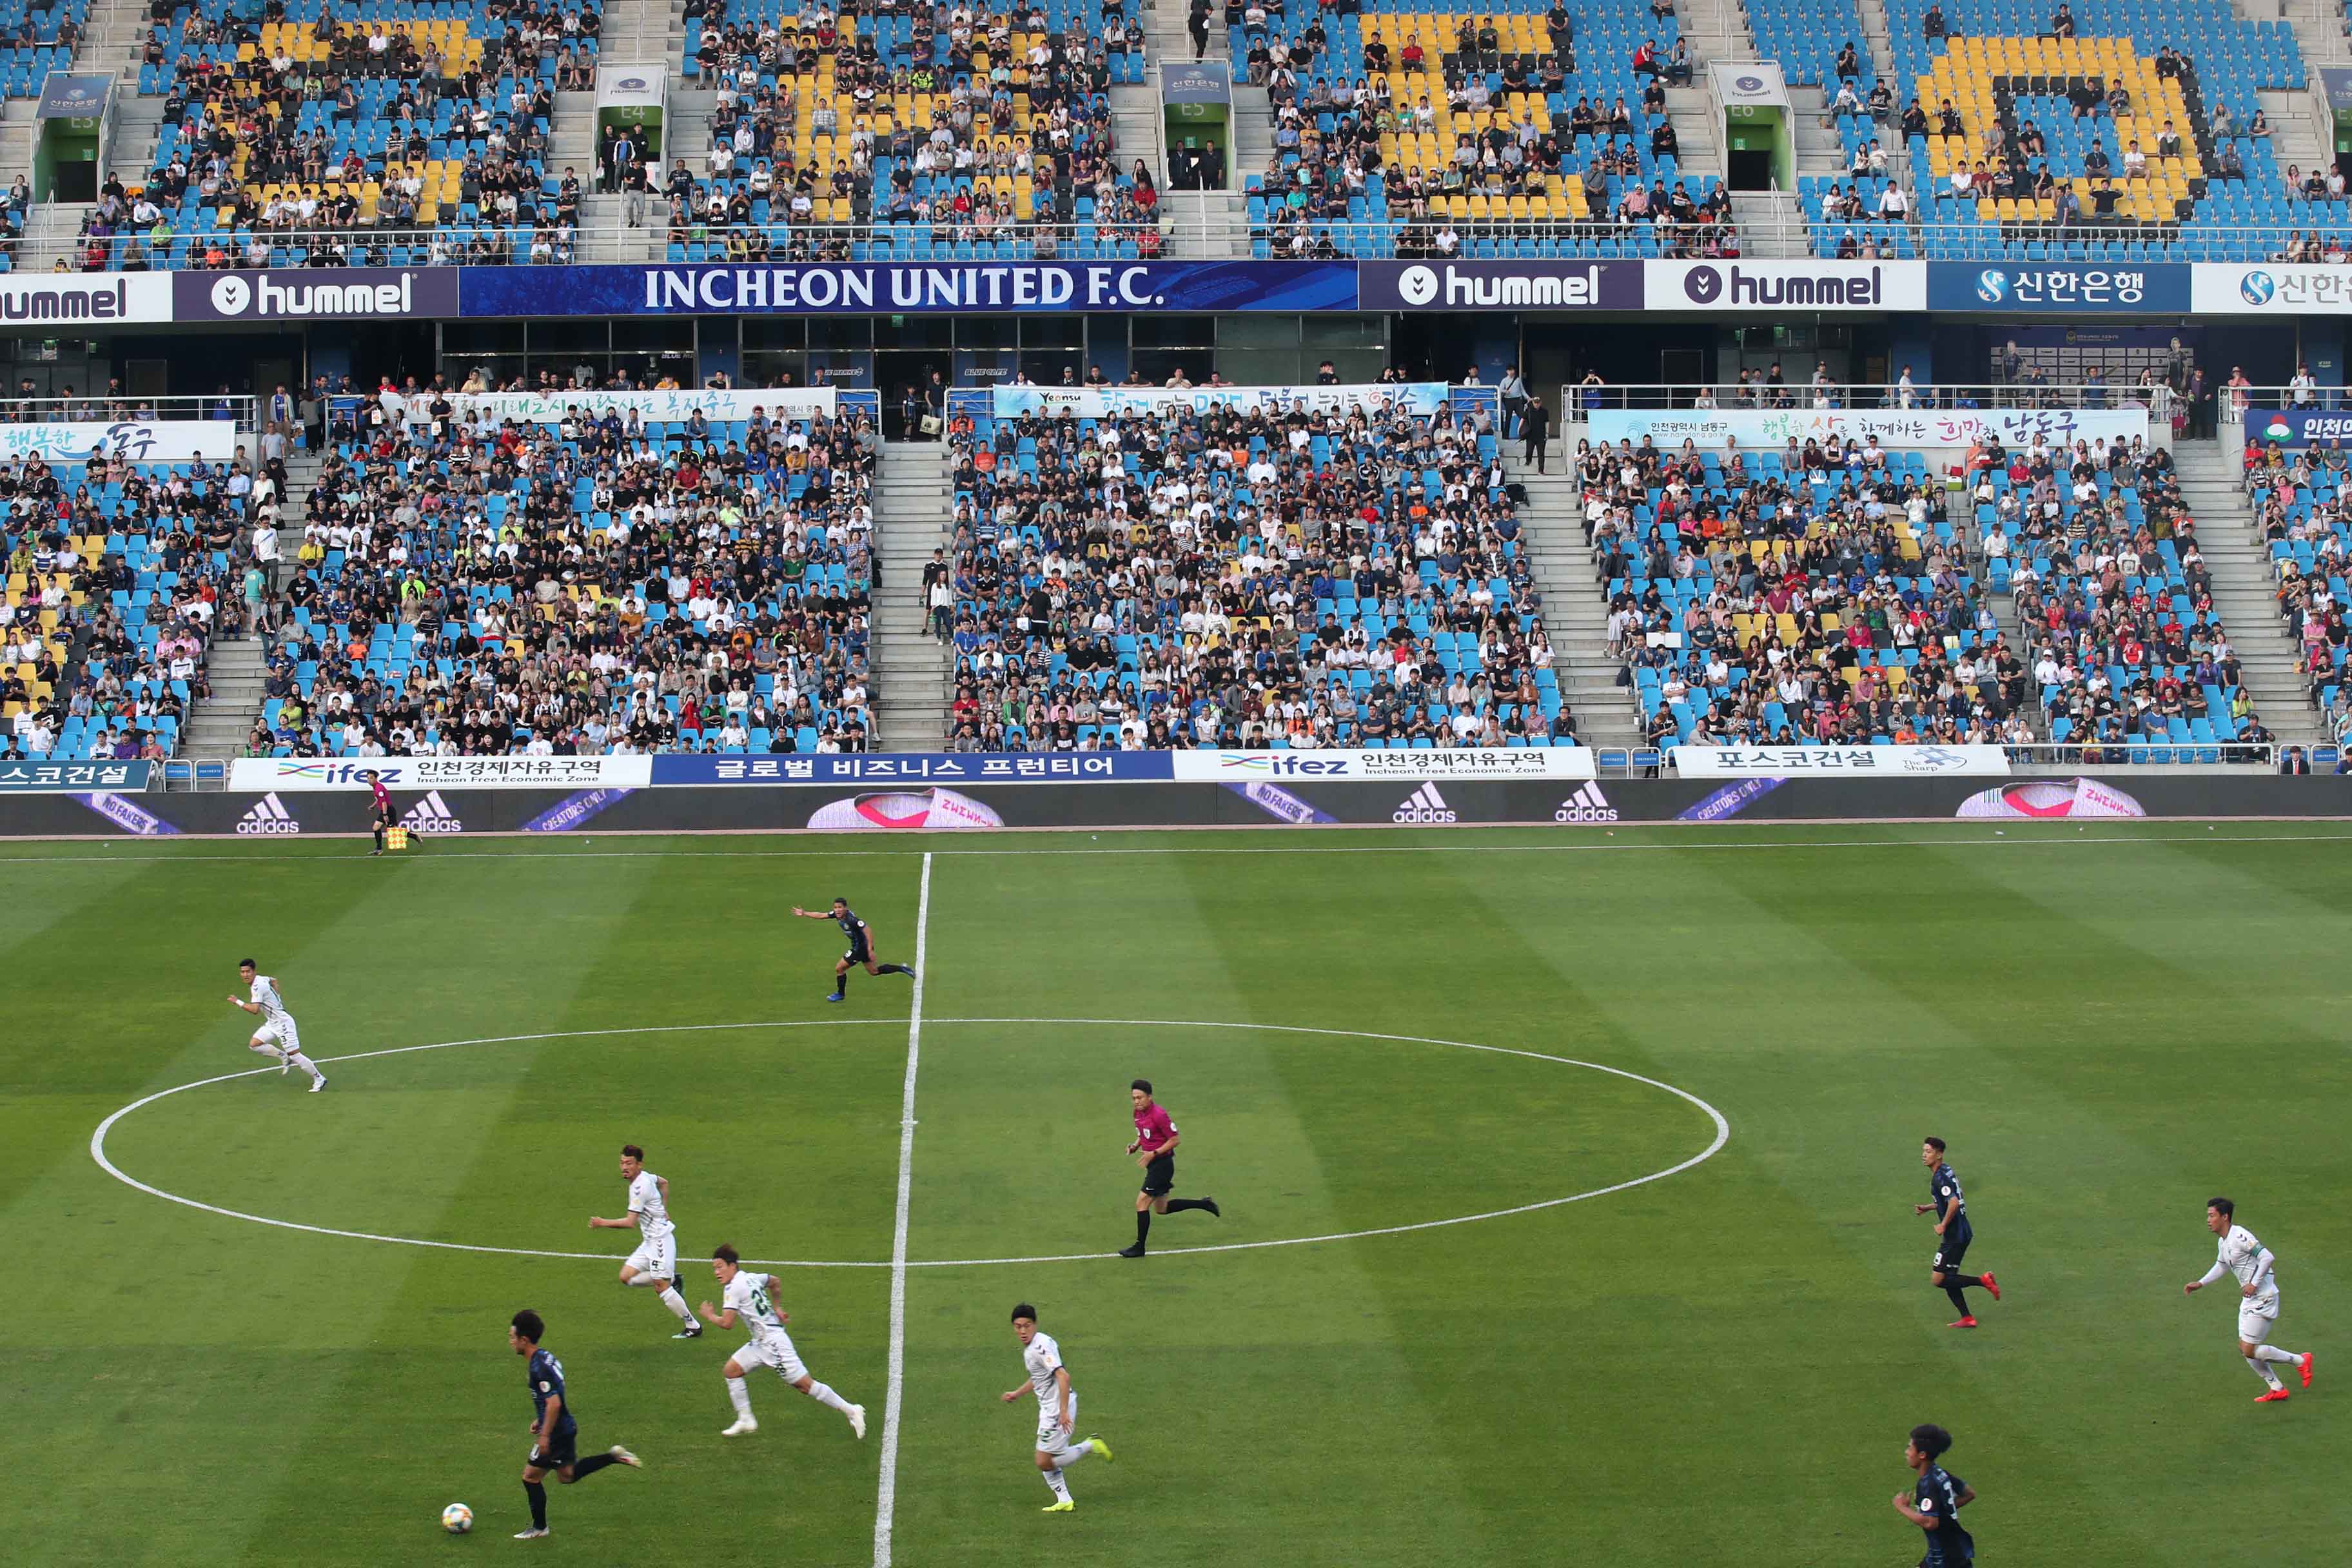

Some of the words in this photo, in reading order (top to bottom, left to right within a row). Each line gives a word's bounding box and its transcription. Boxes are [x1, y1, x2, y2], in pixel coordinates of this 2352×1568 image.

[621, 106, 645, 119] E4
[1181, 103, 1204, 116] E5
[1732, 104, 1754, 117] E6
[71, 117, 93, 128] E3
[645, 268, 875, 308] INCHEON
[890, 267, 1073, 306] UNITED
[1087, 266, 1164, 305] F.C.
[1446, 265, 1598, 305] hummel
[1731, 265, 1881, 304] hummel
[2013, 271, 2144, 303] 신한은행
[2278, 274, 2352, 304] 신한
[0, 279, 126, 319] ummel
[259, 273, 411, 315] hummel
[1039, 392, 1081, 404] Yeonsu
[1651, 422, 1697, 432] 인천광역시
[1701, 422, 1728, 432] 남동구
[2004, 411, 2078, 443] 남동구
[4, 426, 76, 460] 행복한
[106, 423, 157, 460] 동구
[417, 760, 602, 775] 인천경제자유구역
[715, 760, 814, 778] 글로벌
[833, 758, 965, 778] 비즈니스
[981, 757, 1113, 776] 프런티어
[1271, 755, 1349, 774] ifez
[1362, 752, 1545, 767] 인천경제자유구역
[1717, 750, 1876, 768] 포스코건설
[0, 765, 128, 785] 스코건설
[327, 764, 402, 784] ifez
[1257, 785, 1271, 801] NO
[103, 796, 116, 812] NO
[1697, 790, 1741, 820] CREATORS
[542, 801, 585, 830] CREATORS
[1393, 807, 1456, 823] adidas
[1556, 806, 1618, 822] adidas
[237, 818, 299, 834] adidas
[398, 816, 462, 832] adidas
